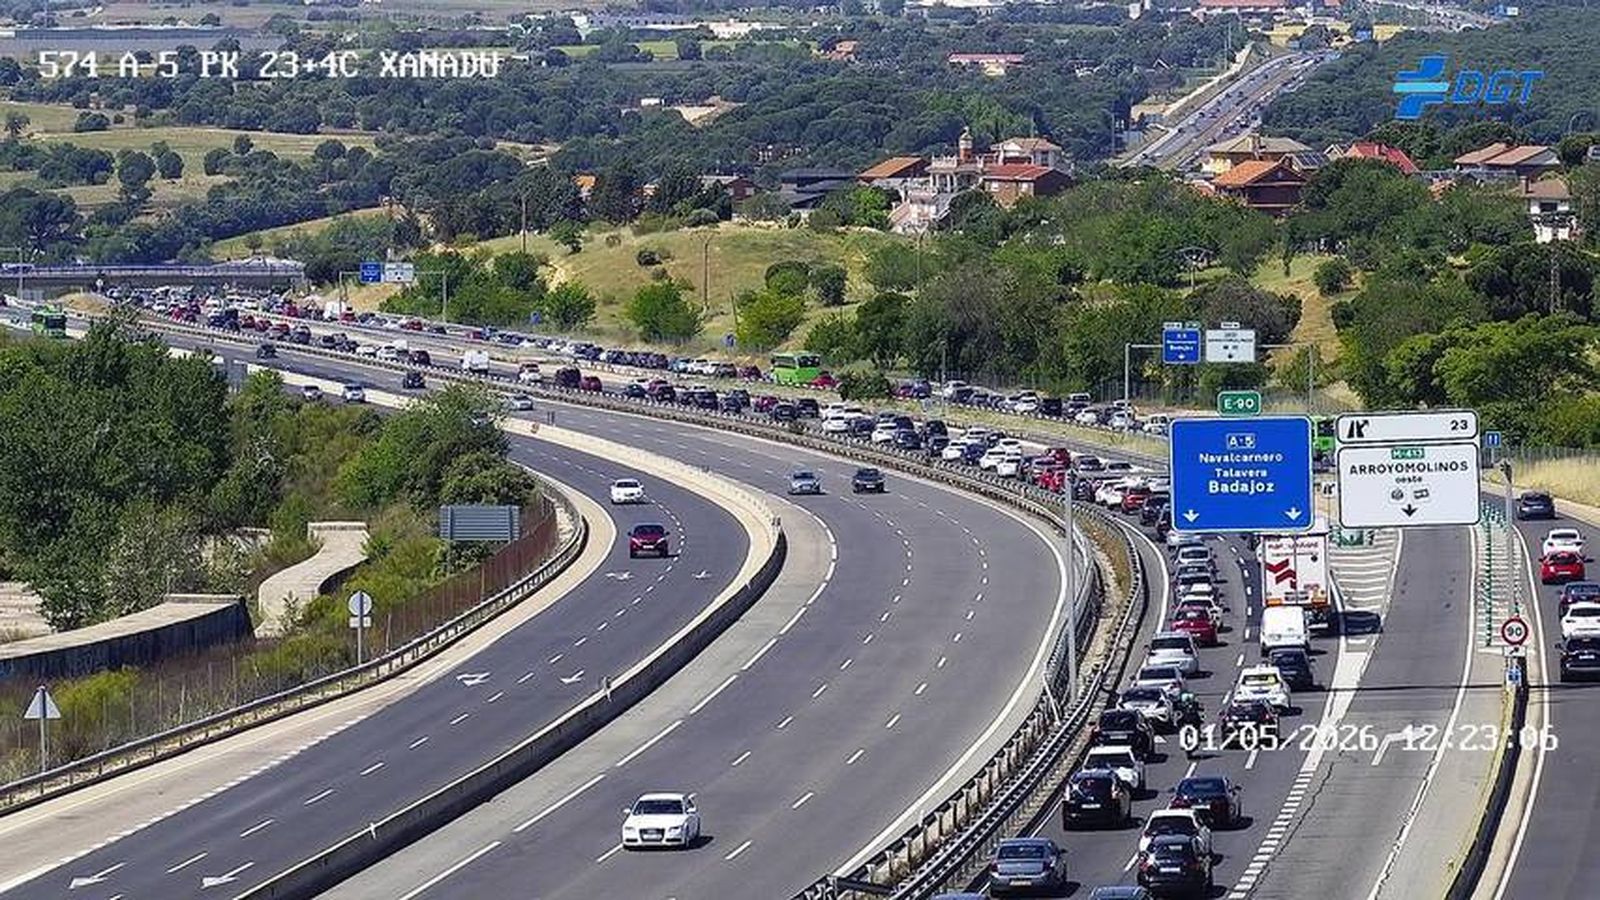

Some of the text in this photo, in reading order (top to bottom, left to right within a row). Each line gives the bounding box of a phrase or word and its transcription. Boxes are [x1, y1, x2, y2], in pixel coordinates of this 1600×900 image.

[1223, 398, 1255, 410] E-90
[1450, 419, 1469, 431] 23
[1199, 453, 1283, 463] Navalcarnero
[1215, 468, 1267, 478] Talavera
[1349, 460, 1469, 475] ARROYOMOLINOS
[1208, 480, 1275, 494] Badajoz
[1506, 626, 1523, 637] 90
